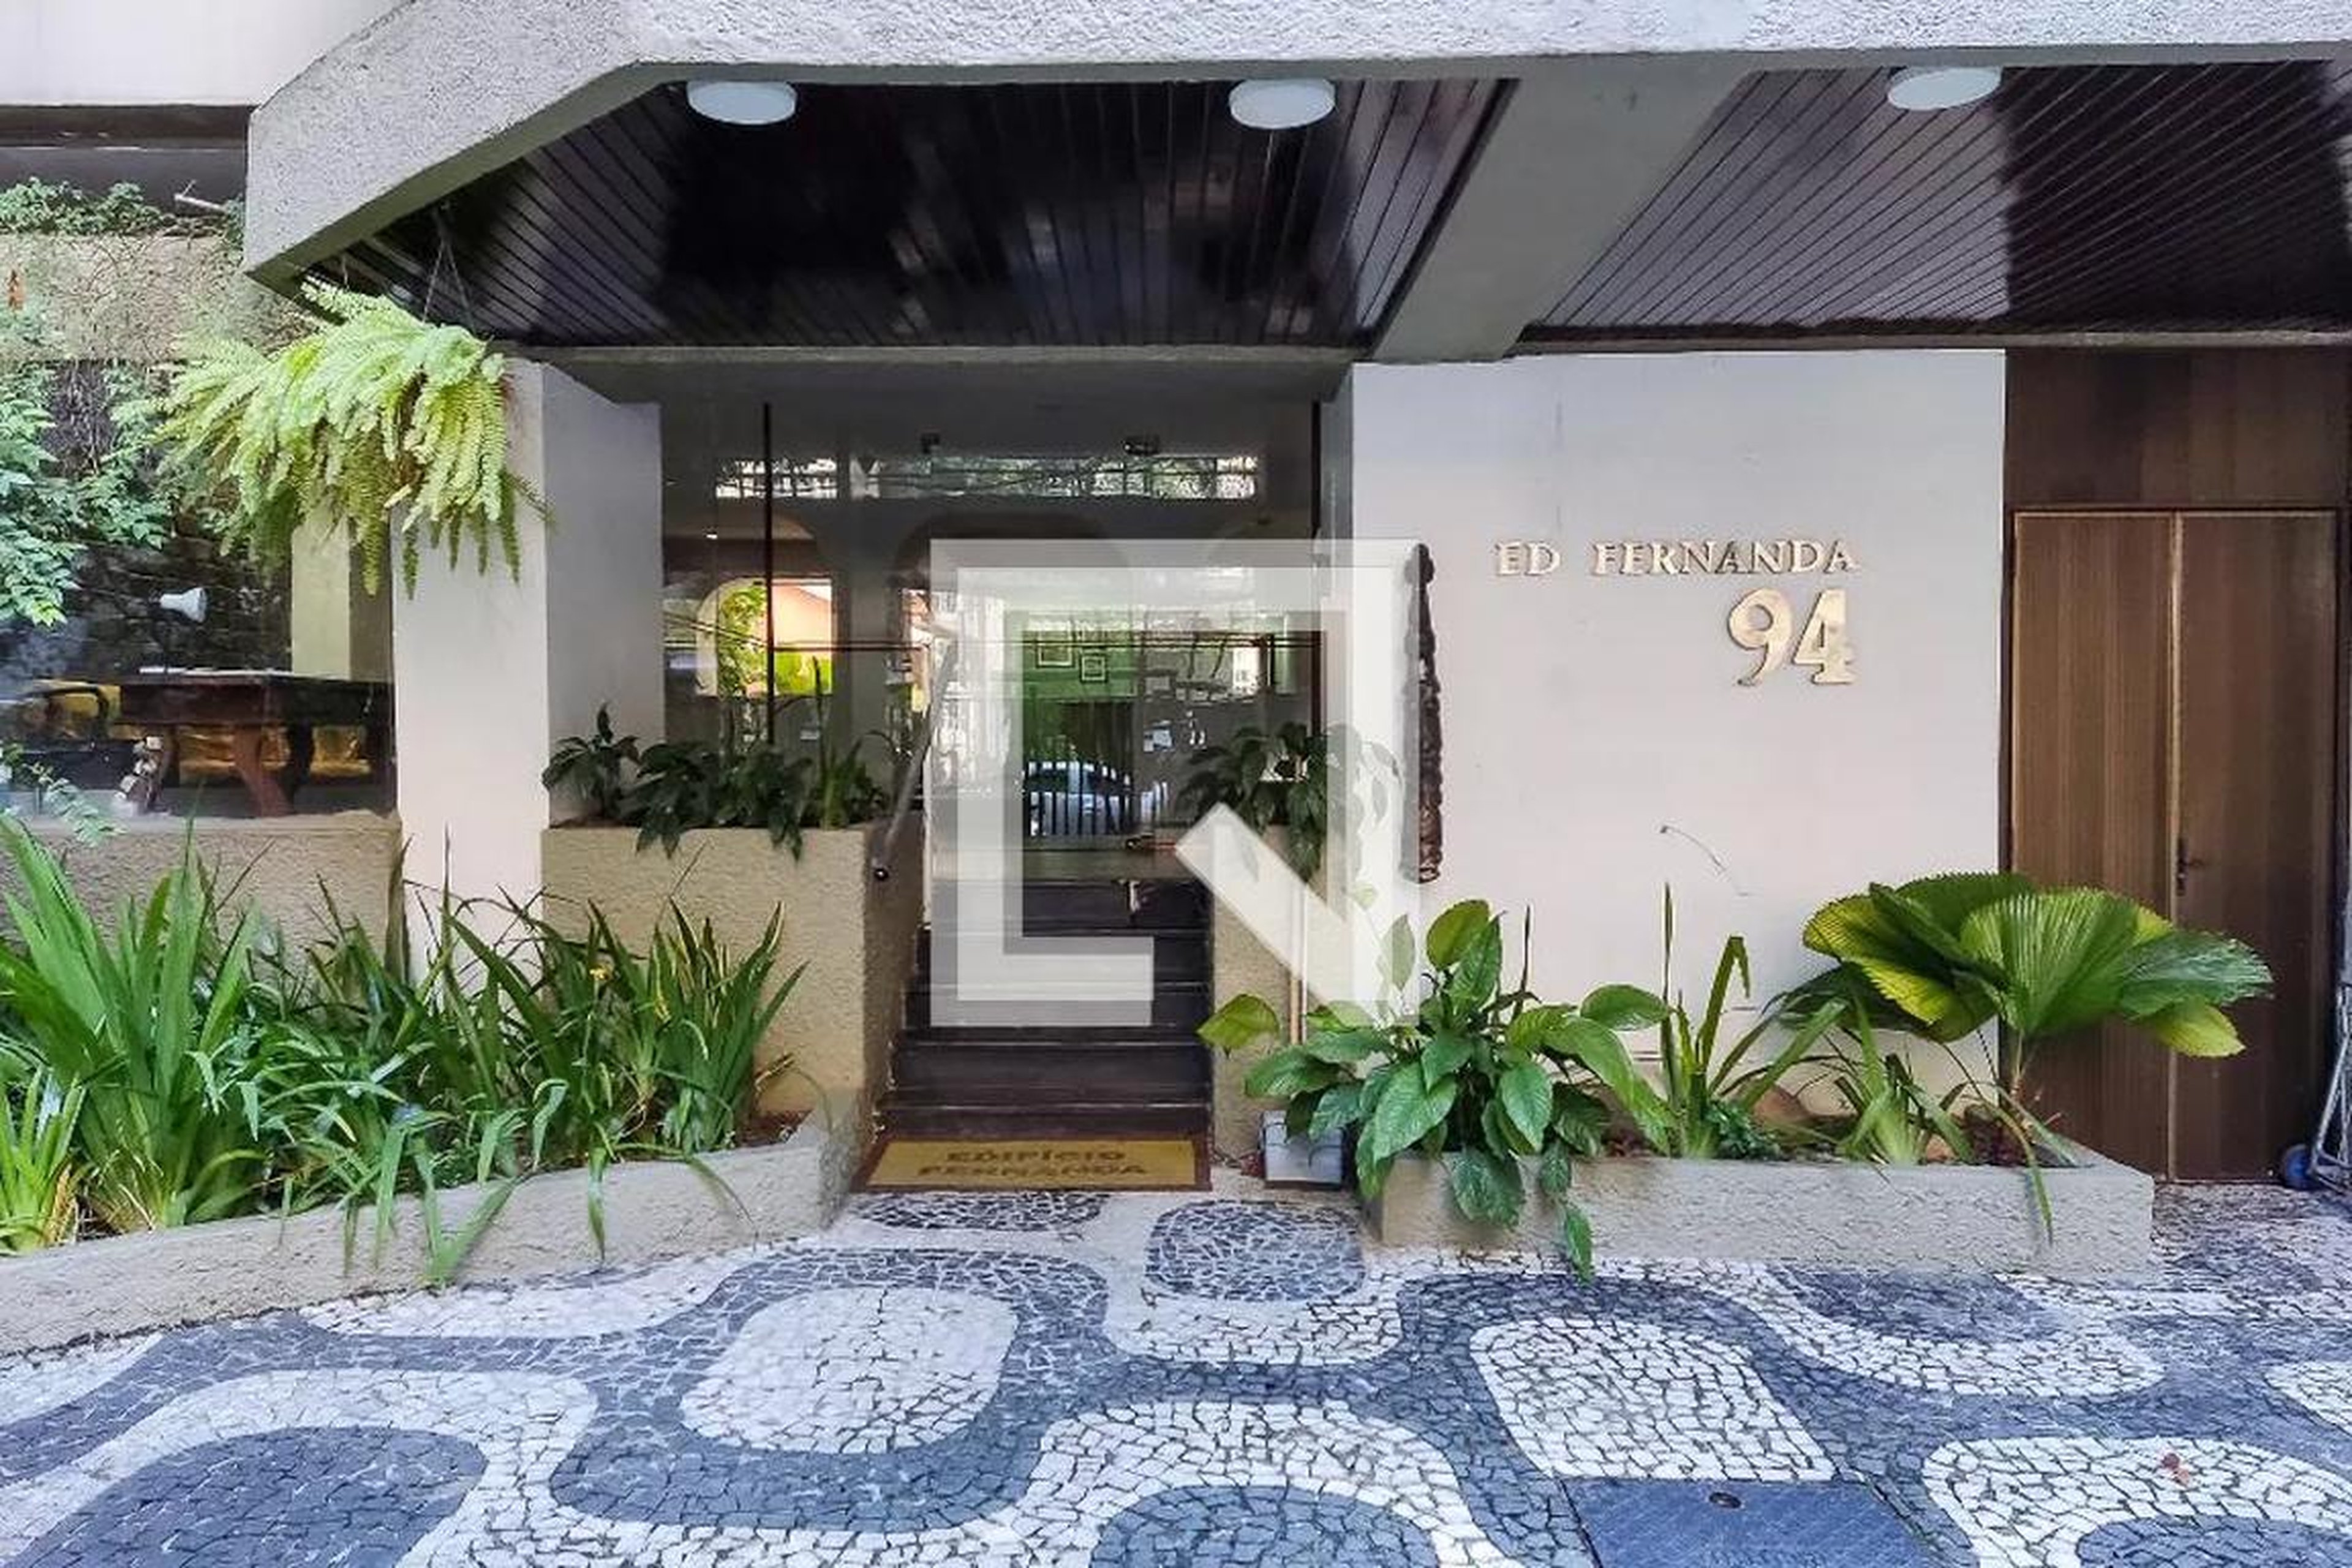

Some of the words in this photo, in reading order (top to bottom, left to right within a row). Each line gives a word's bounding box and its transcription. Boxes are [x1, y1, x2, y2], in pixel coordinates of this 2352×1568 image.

[1494, 541, 1561, 576] ED
[1593, 540, 1858, 576] FERNANDA
[1726, 588, 1856, 687] 94
